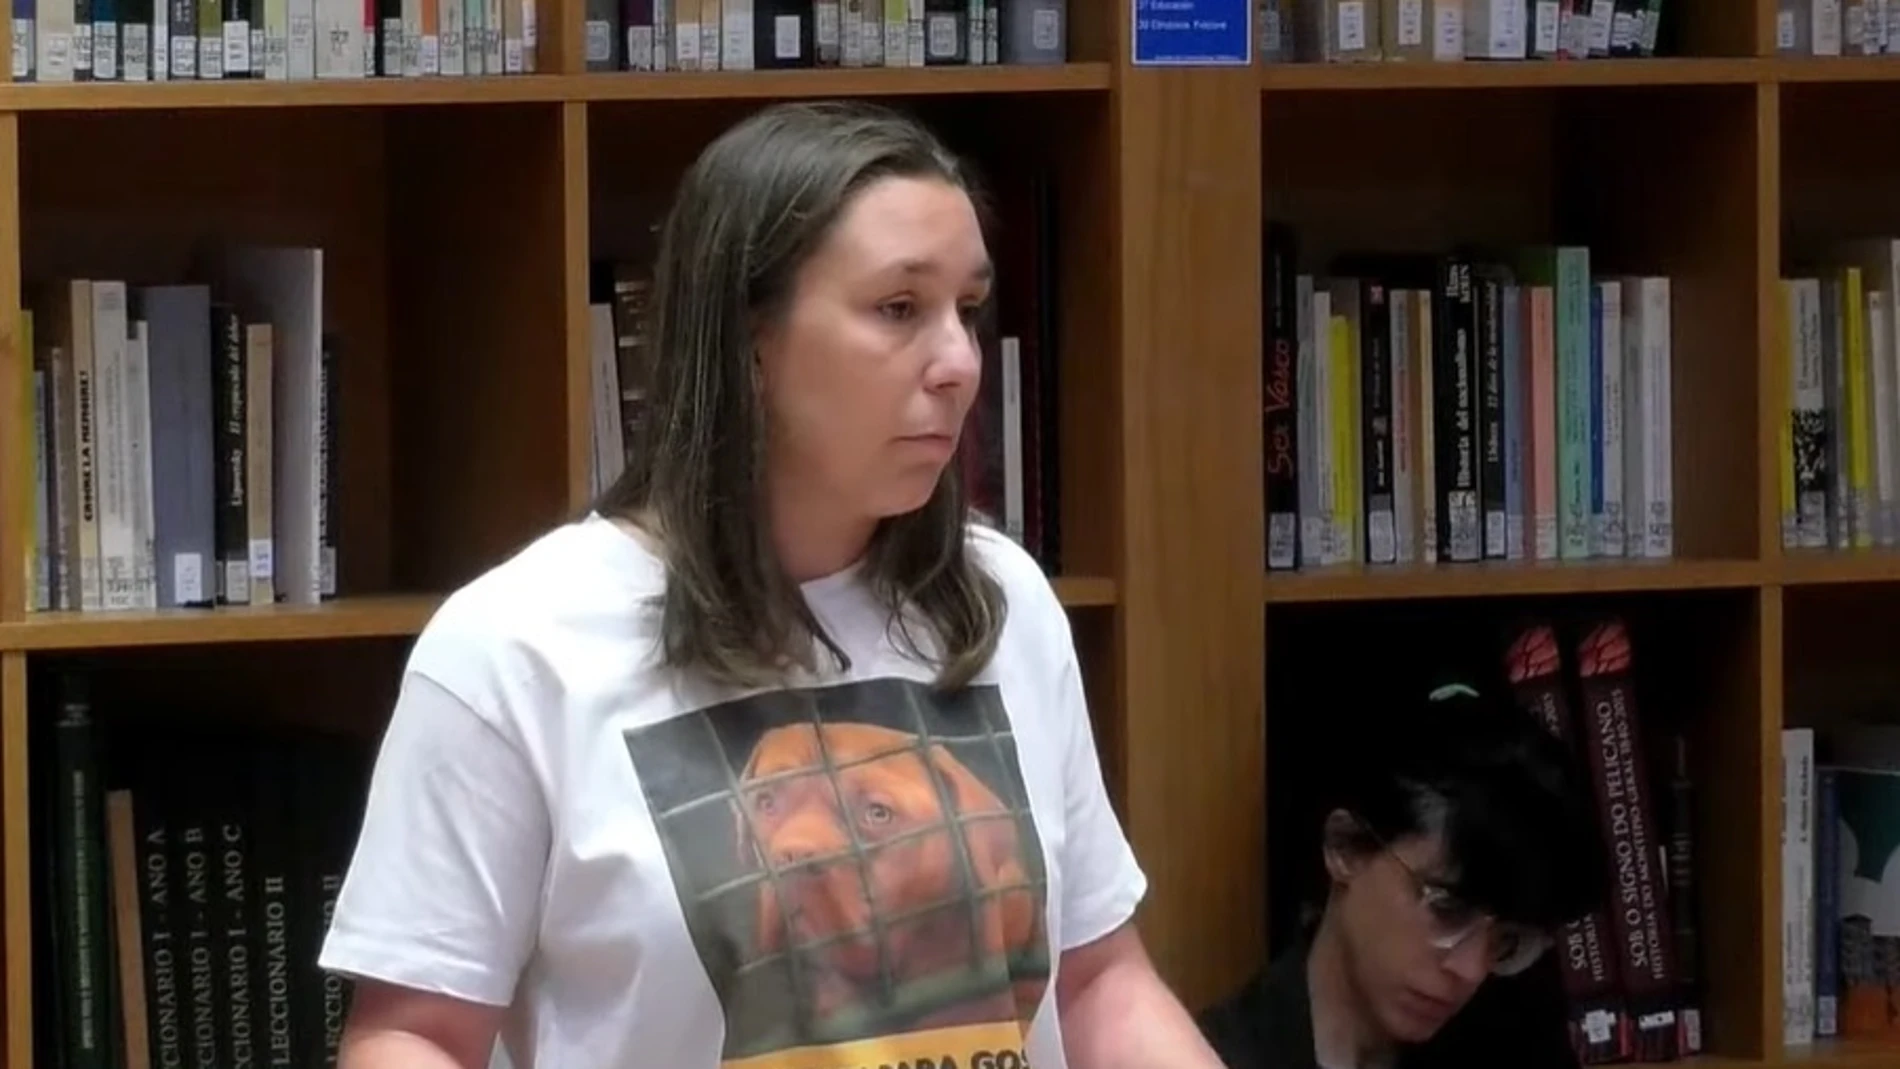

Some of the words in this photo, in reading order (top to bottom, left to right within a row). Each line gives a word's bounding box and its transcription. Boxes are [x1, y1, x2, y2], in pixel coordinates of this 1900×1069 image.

[1264, 340, 1291, 412] Vasco
[1596, 701, 1625, 798] PELICANO
[146, 828, 166, 845] A
[184, 826, 204, 844] B
[222, 823, 242, 842] C
[1611, 802, 1628, 834] DO
[148, 854, 168, 906] ANO
[186, 852, 207, 904] ANO
[224, 850, 244, 902] ANO
[1616, 841, 1640, 904] SIGNO
[1624, 908, 1641, 926] O
[1568, 932, 1588, 970] SOB
[1631, 930, 1648, 968] SOB
[152, 949, 181, 1069] CIONARIO
[191, 947, 216, 1069] CIONARIO
[266, 900, 292, 1066] LECCIONARIO
